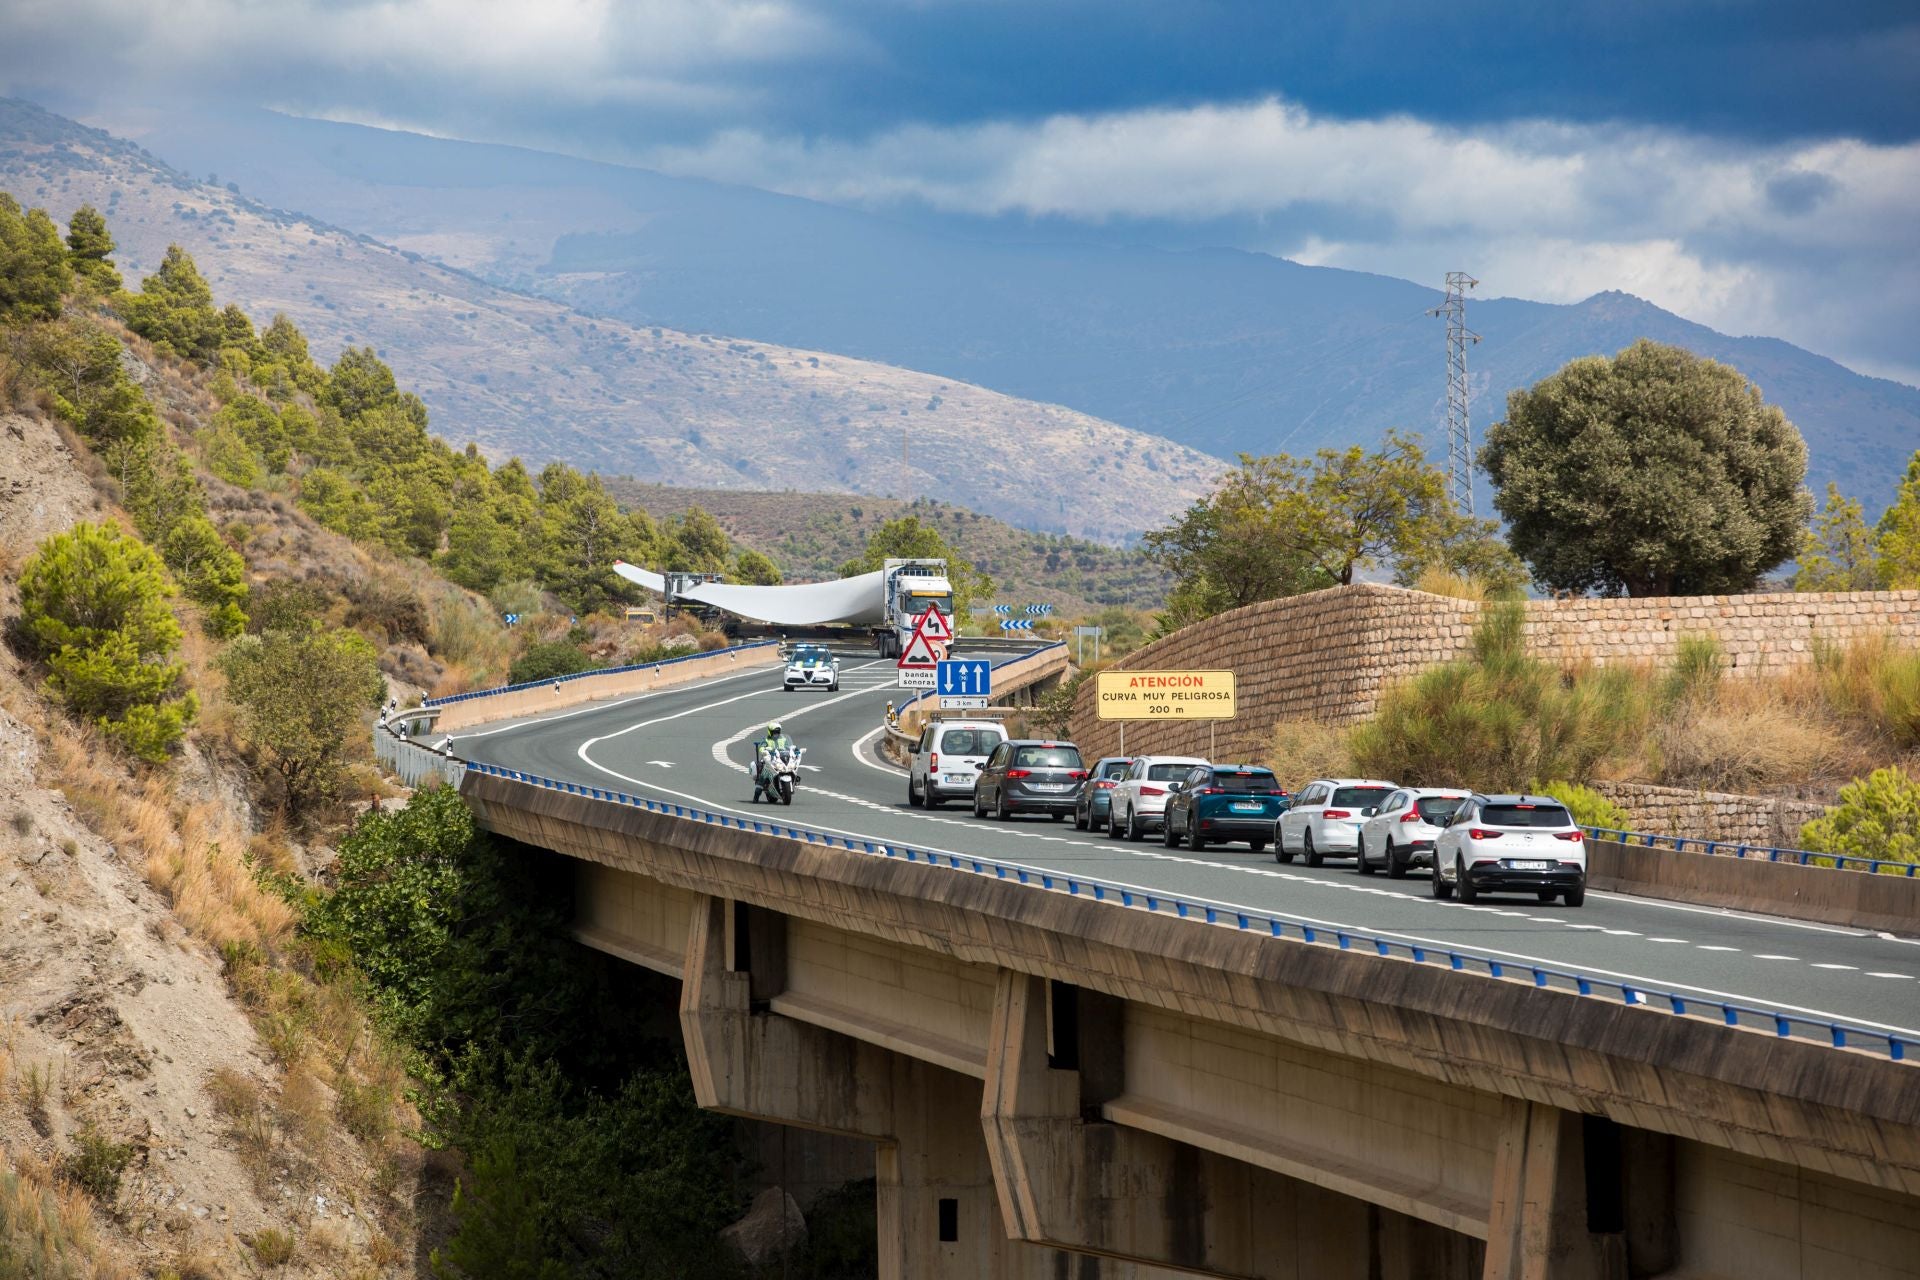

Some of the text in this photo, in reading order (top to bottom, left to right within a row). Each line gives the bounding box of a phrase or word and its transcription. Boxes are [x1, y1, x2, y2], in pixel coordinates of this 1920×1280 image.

[1129, 674, 1204, 688] ATENCIÓN
[1102, 691, 1231, 701] CURVA MUY PELIGROSA
[1149, 705, 1170, 714] 200
